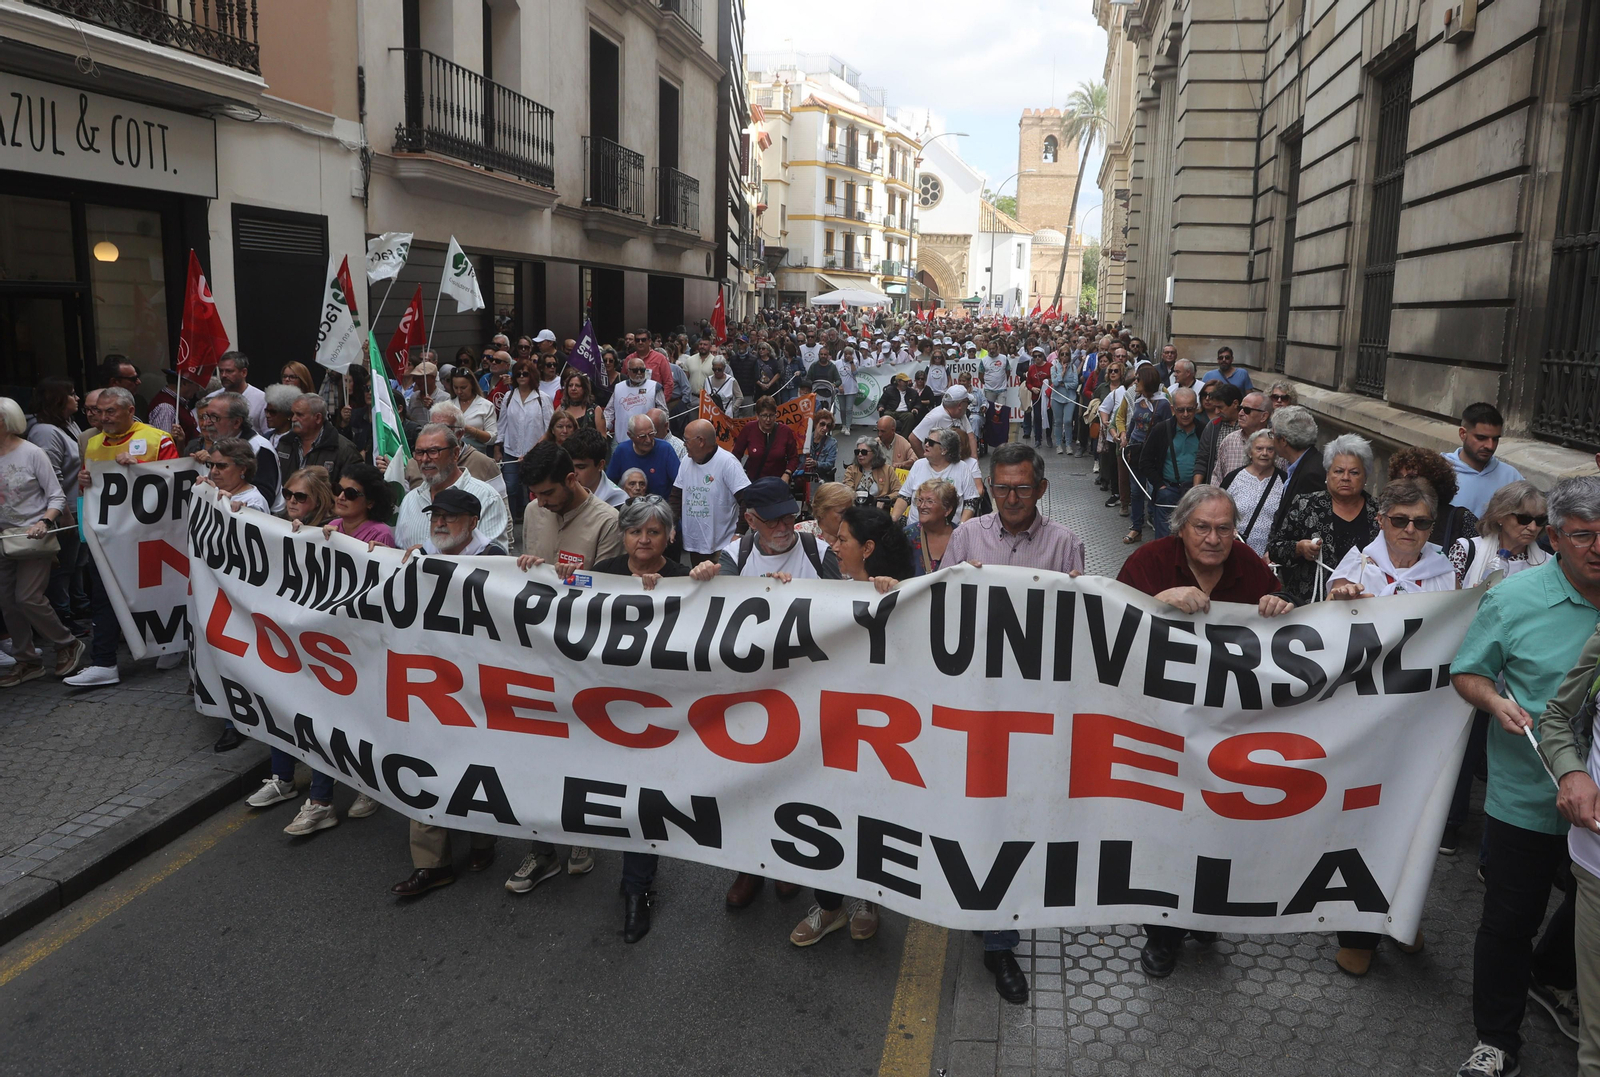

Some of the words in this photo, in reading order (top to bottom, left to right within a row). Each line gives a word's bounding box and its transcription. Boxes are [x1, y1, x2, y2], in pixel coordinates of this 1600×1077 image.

[76, 93, 101, 154] &
[111, 113, 179, 175] COTT.
[98, 470, 199, 526] POR
[692, 492, 702, 500] NO
[277, 537, 502, 642] ANDALUZA
[514, 580, 829, 673] PUBLICA
[852, 590, 902, 665] Y
[930, 583, 1451, 710] UNIVERSAL.
[206, 587, 358, 696] LOS
[386, 651, 1383, 821] RECORTES.
[220, 676, 521, 826] BLANCA
[561, 776, 722, 849] EN
[771, 802, 1390, 917] SEVILLA
